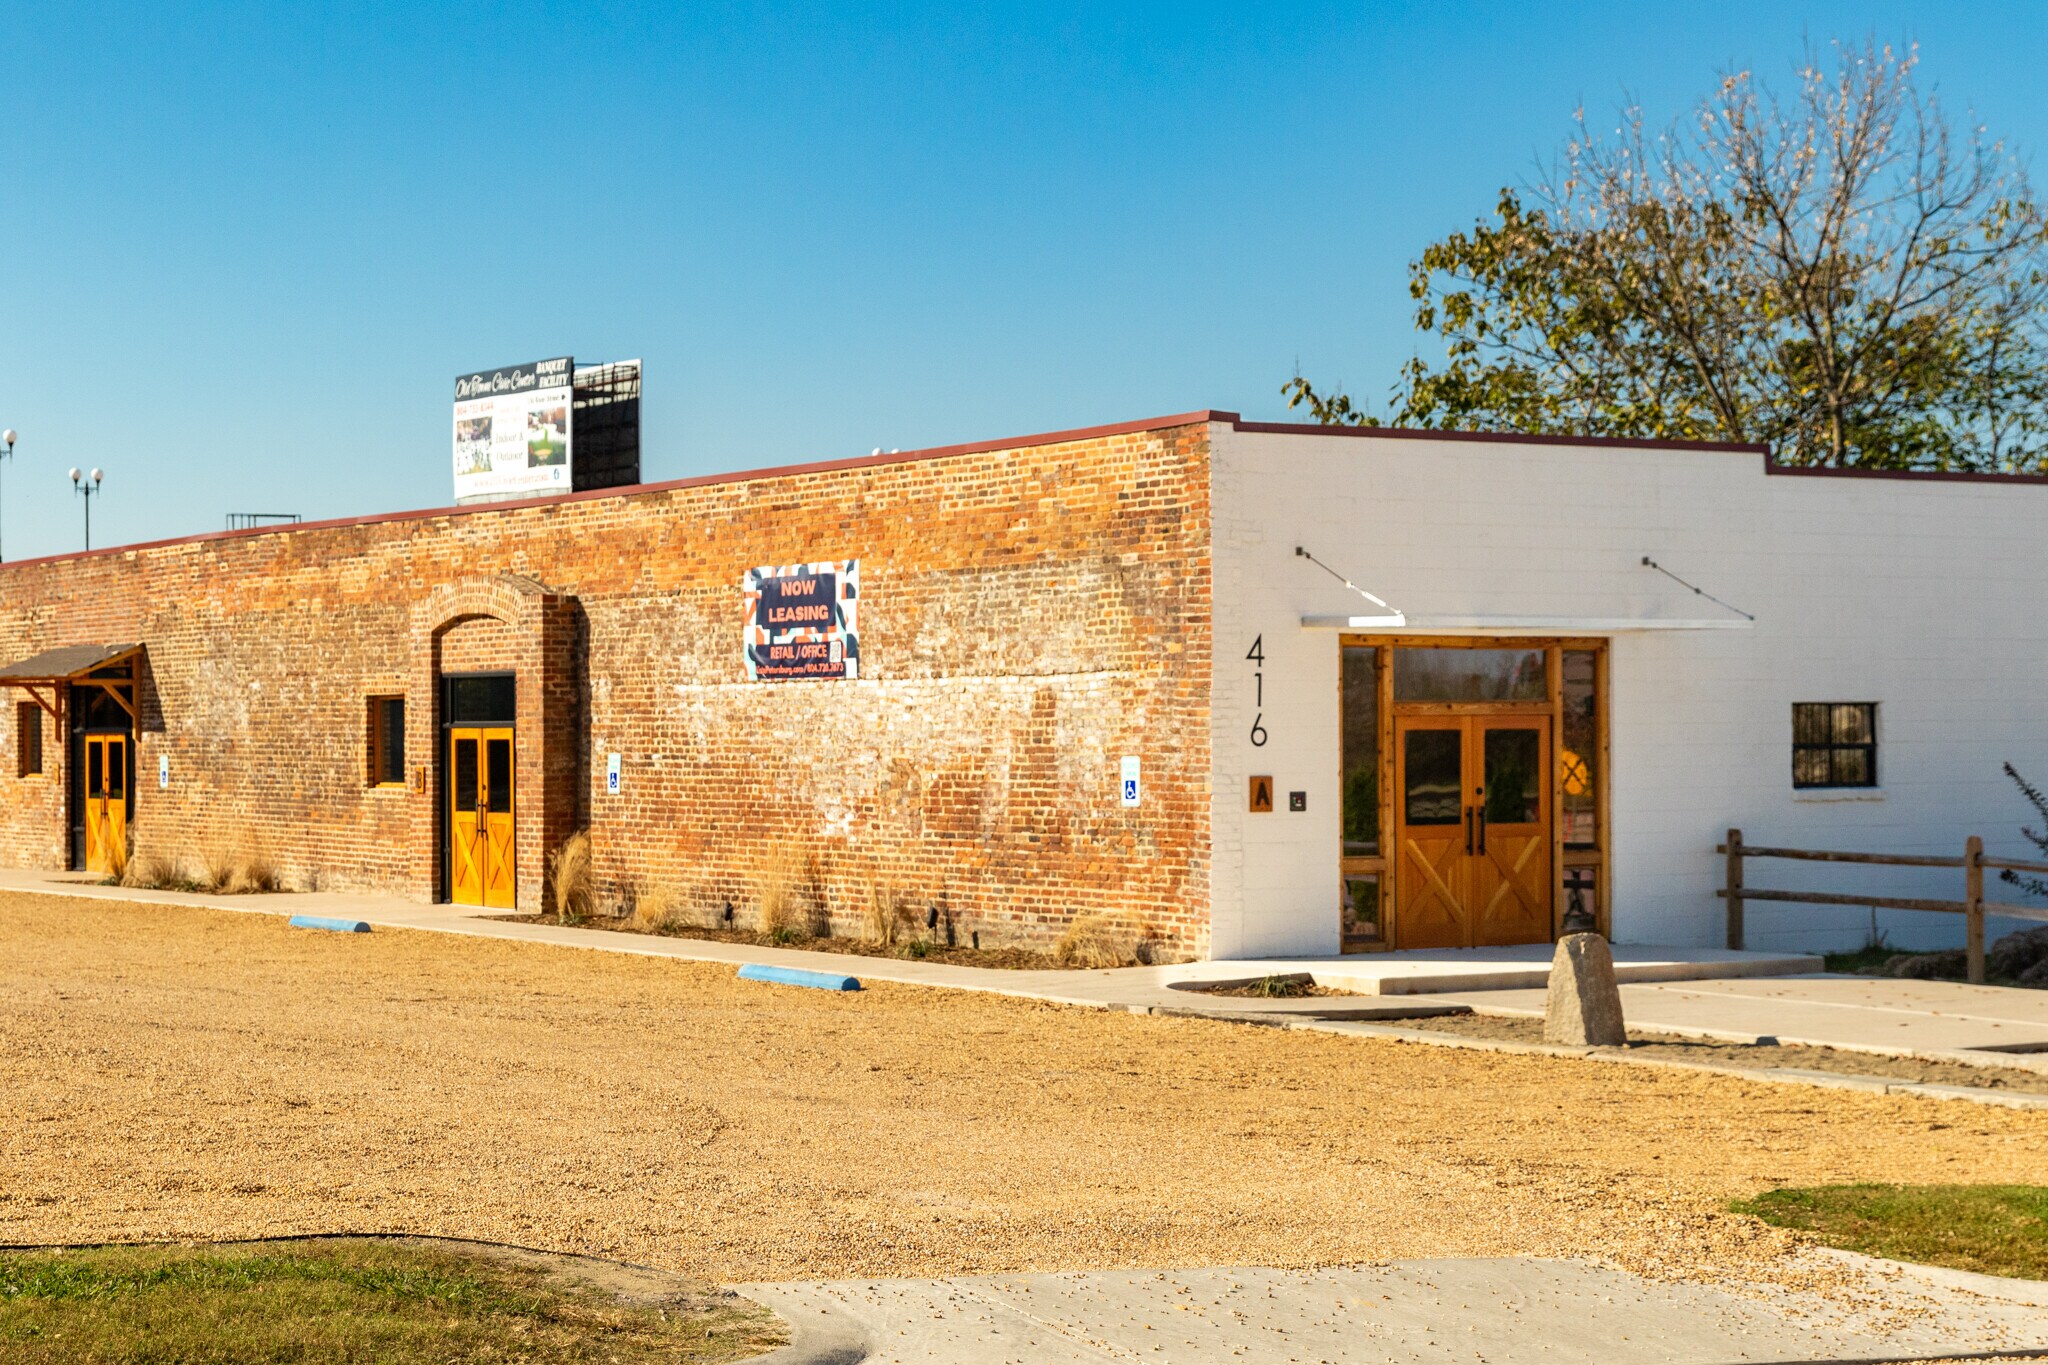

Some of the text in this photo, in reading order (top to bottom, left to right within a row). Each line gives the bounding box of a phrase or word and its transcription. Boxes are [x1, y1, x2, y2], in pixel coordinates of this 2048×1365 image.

[539, 374, 569, 388] FACILITY
[781, 579, 816, 597] NOW
[768, 604, 829, 622] LEASING
[770, 646, 795, 660] RETAIL
[801, 644, 828, 659] OFFICE
[1245, 633, 1268, 747] 416
[1255, 780, 1270, 806] A
